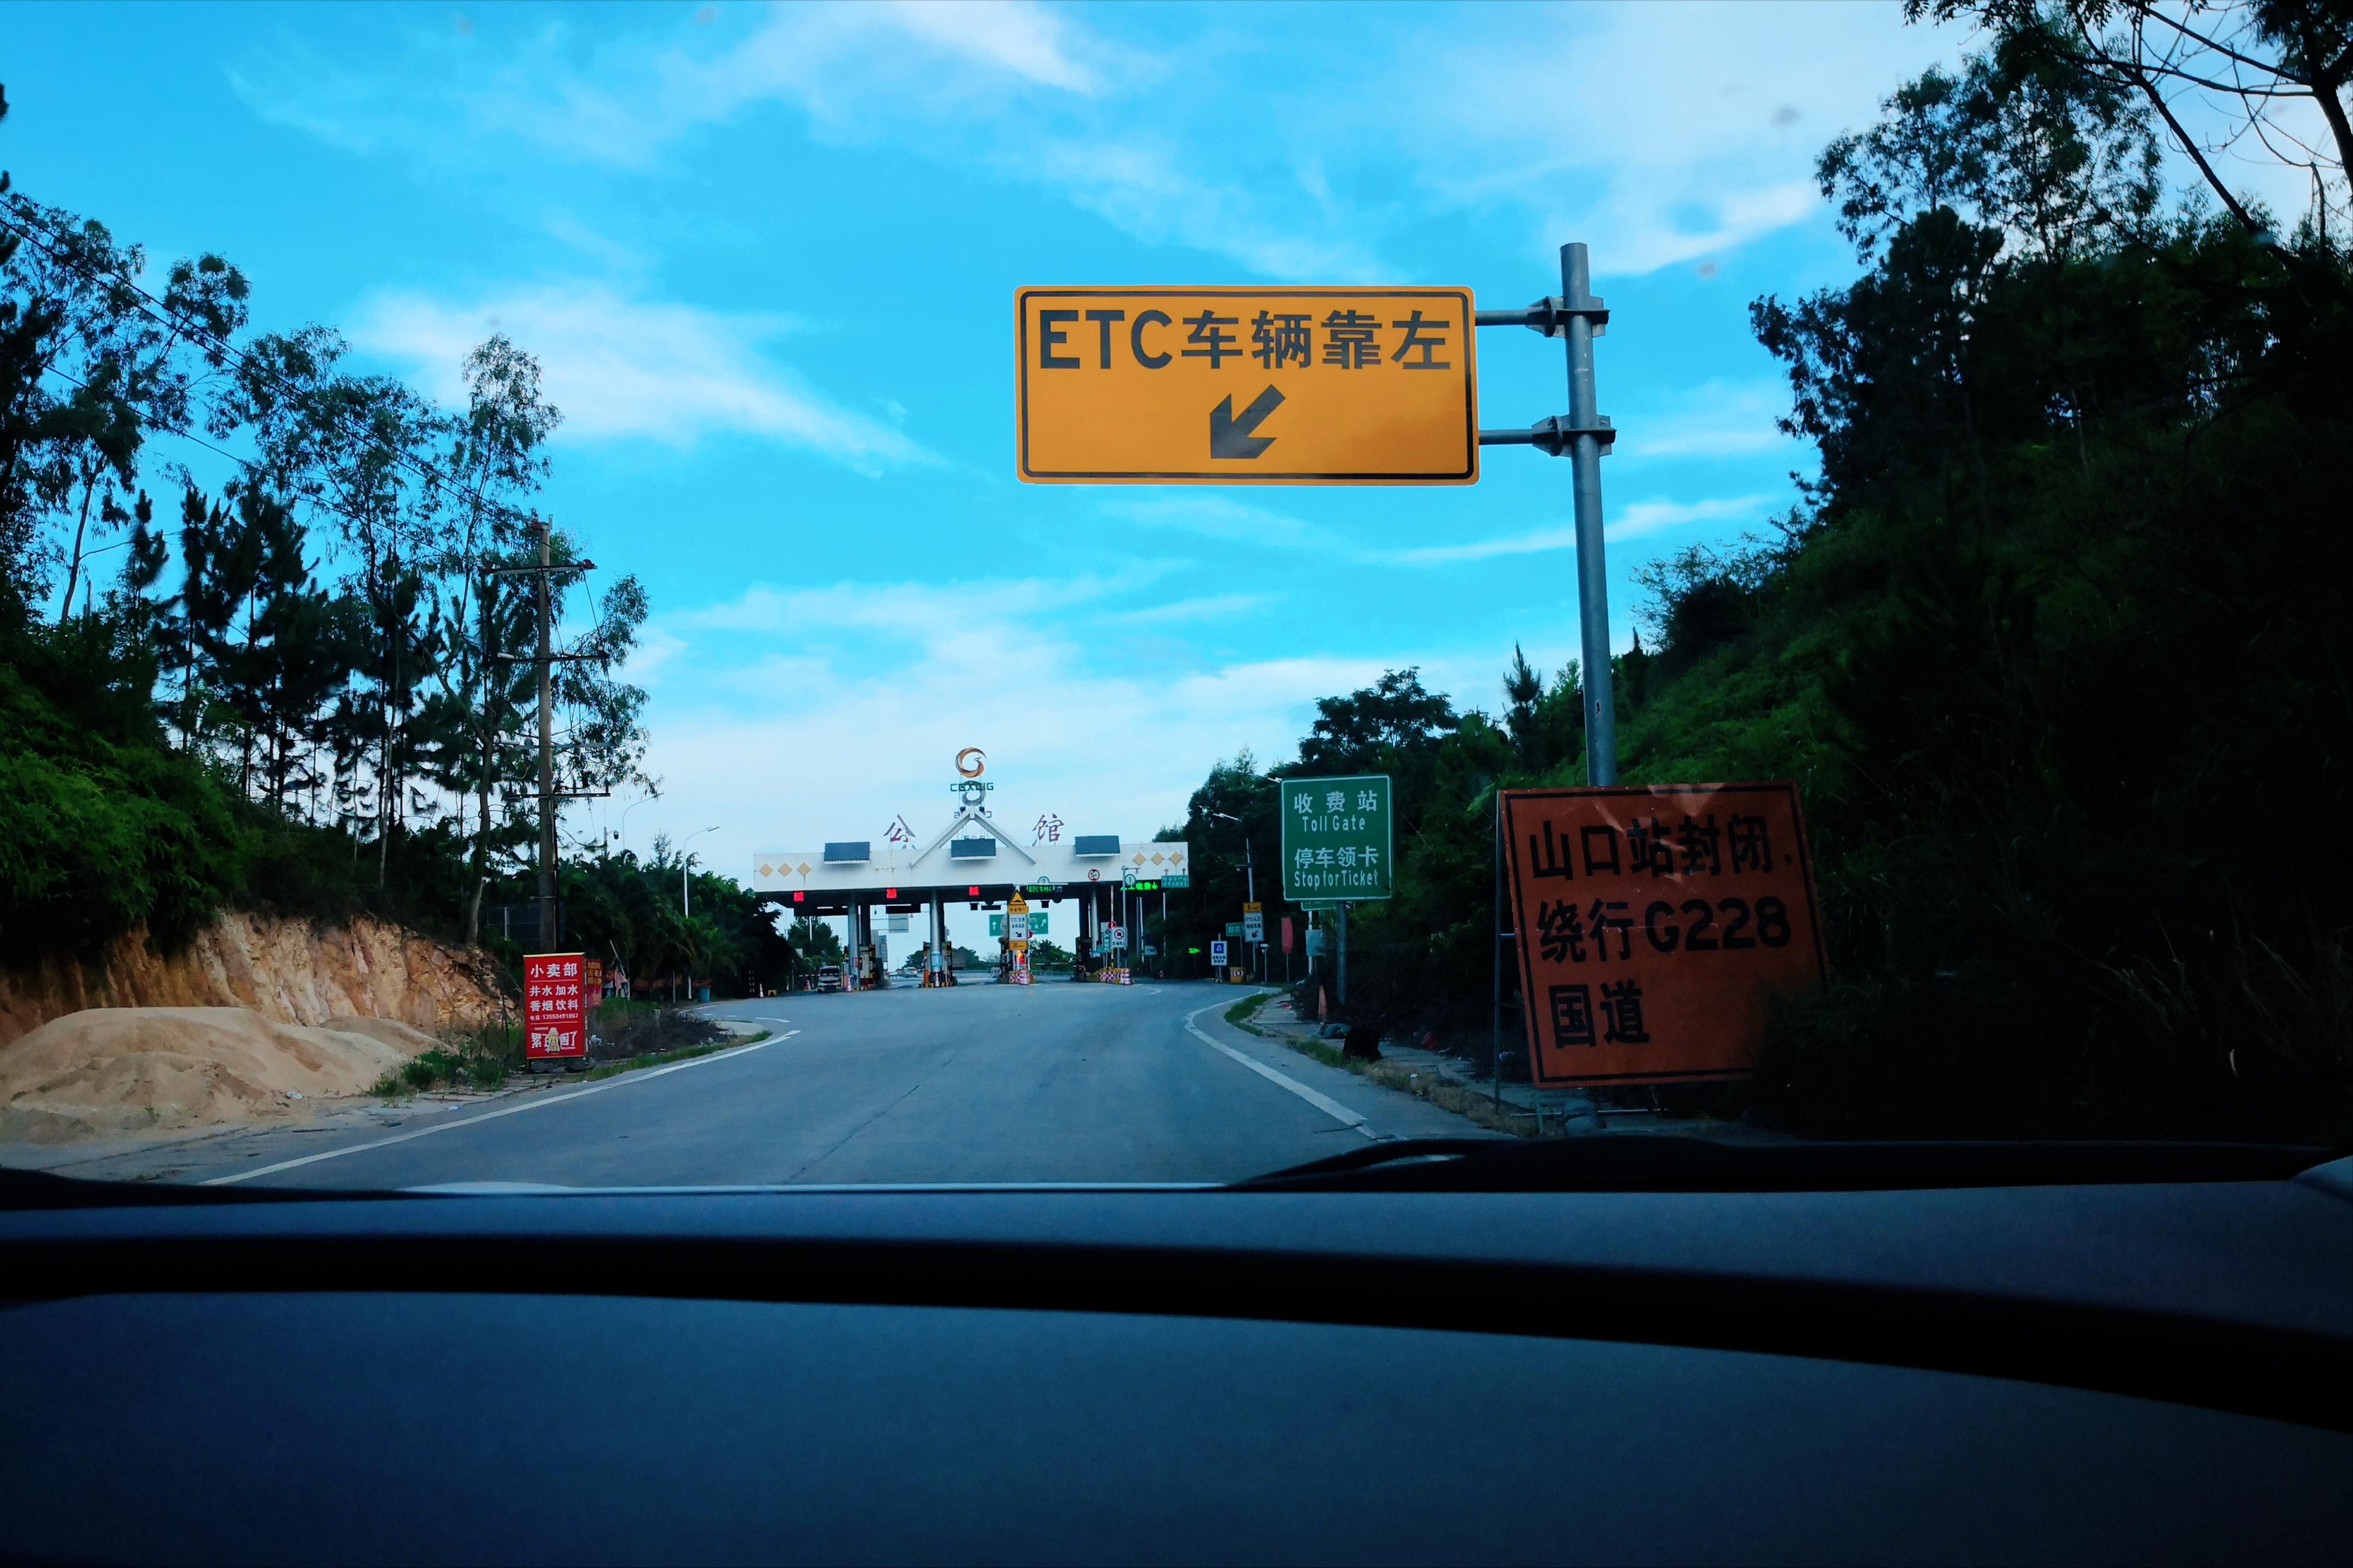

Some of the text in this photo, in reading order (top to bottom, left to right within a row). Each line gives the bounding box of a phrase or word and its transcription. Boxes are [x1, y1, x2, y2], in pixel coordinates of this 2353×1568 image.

[1039, 309, 1451, 370] ETC车辆靠左
[1294, 790, 1378, 814] 收费站
[1302, 815, 1365, 832] Toll Gate
[1294, 845, 1379, 869] 停车领卡
[1295, 870, 1320, 891] Stop
[1341, 868, 1378, 886] Ticket
[1536, 896, 1791, 964] 绕行G228
[530, 963, 578, 978] 小卖部
[529, 983, 579, 997] 井水 加水
[530, 999, 579, 1012] 香烟 饮料
[1548, 979, 1650, 1049] 国道
